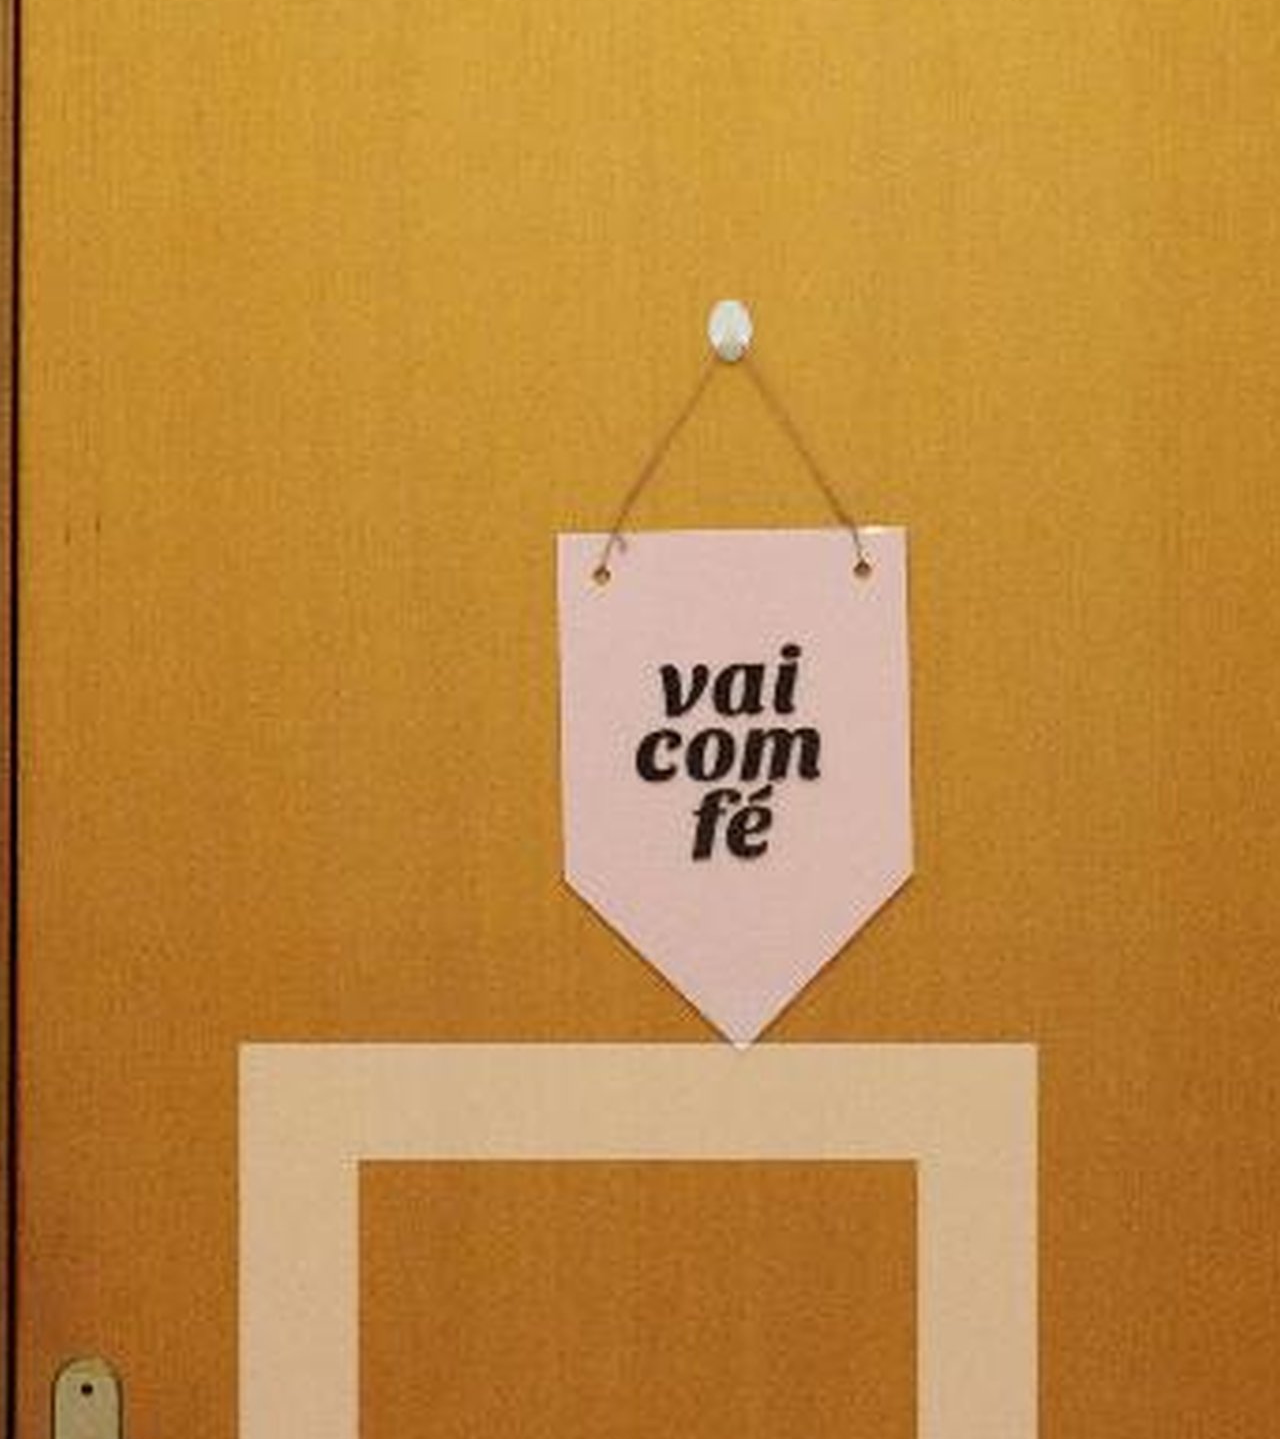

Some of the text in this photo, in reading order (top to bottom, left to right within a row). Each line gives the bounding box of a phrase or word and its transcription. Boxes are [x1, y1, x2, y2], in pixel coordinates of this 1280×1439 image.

[659, 643, 802, 718] vai
[635, 727, 821, 783] com
[692, 783, 774, 861] fé
